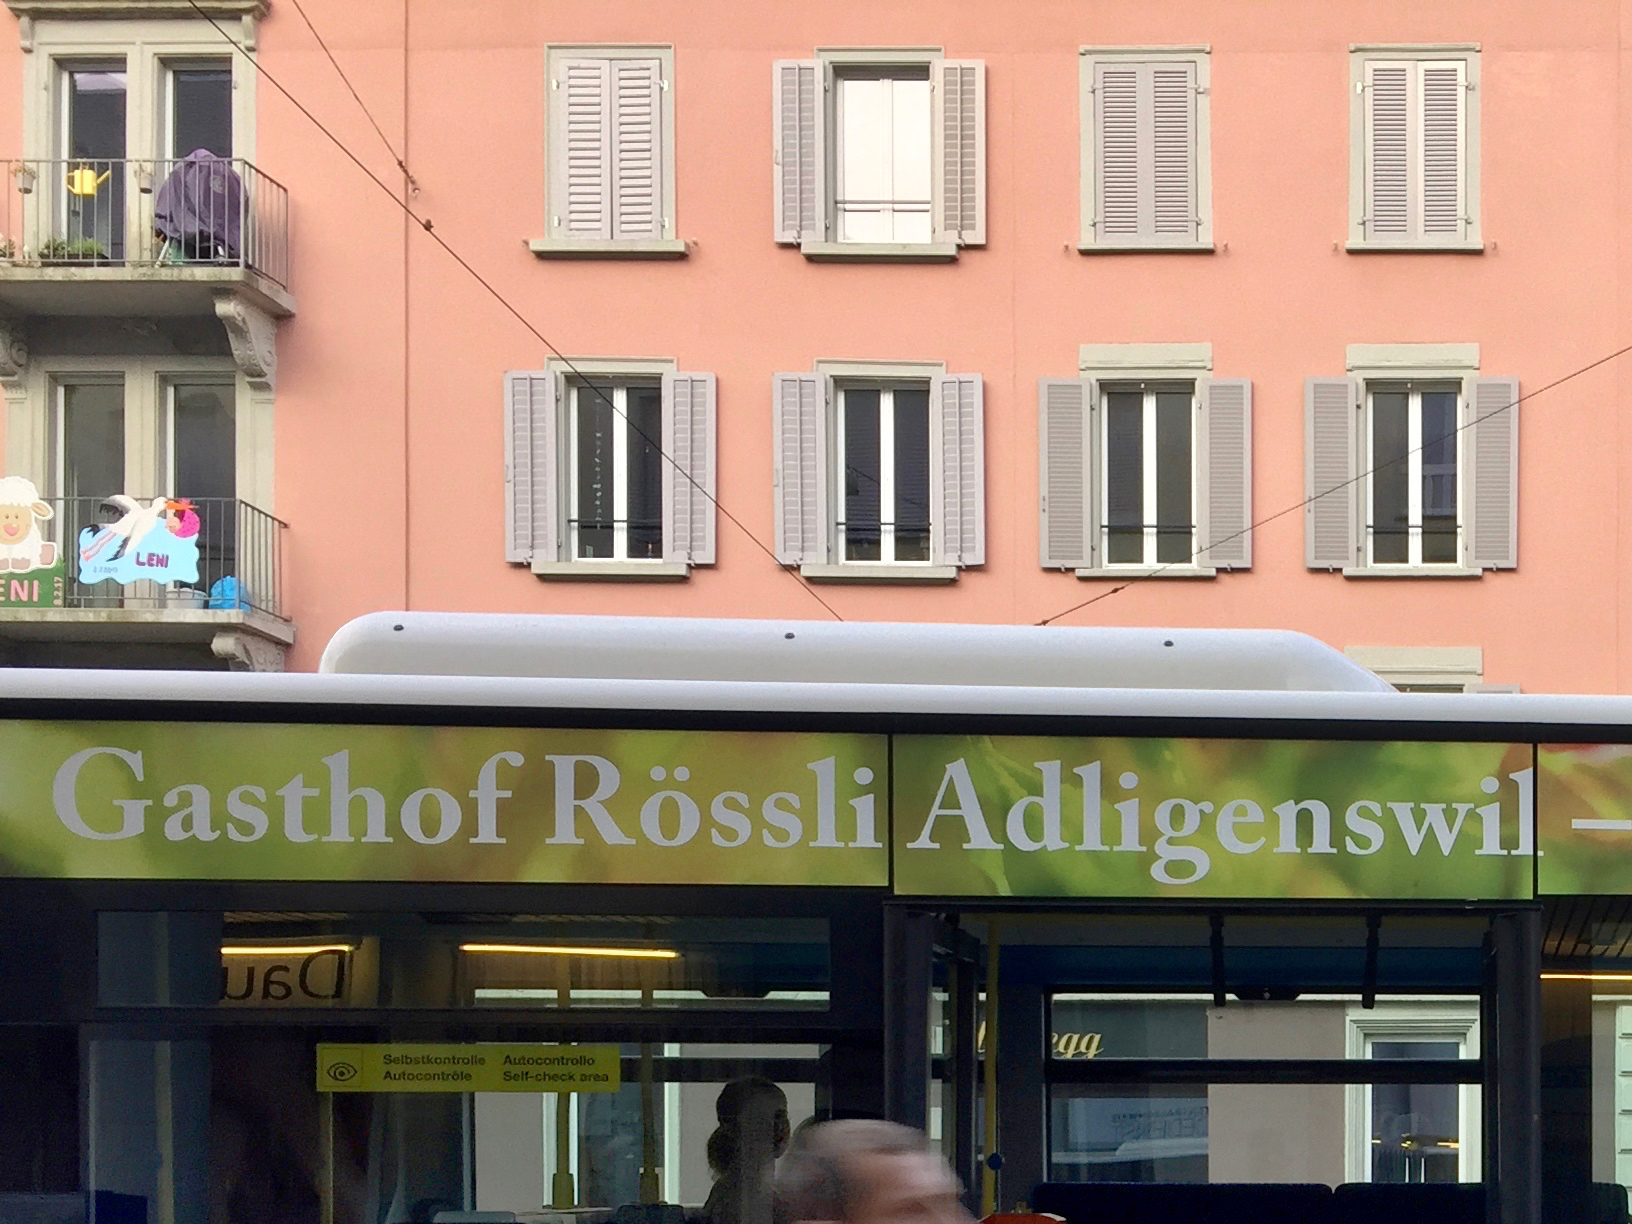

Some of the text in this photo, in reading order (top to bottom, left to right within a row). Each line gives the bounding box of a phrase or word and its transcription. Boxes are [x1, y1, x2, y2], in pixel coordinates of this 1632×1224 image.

[135, 551, 169, 569] LENI
[53, 746, 525, 846] Gasthof
[545, 754, 884, 850] Rössli
[906, 756, 1544, 886] Adligenswil
[383, 1054, 596, 1067] Selbstkontrolle Autocontrollo
[383, 1070, 609, 1083] Autocontrôle Self-check area
